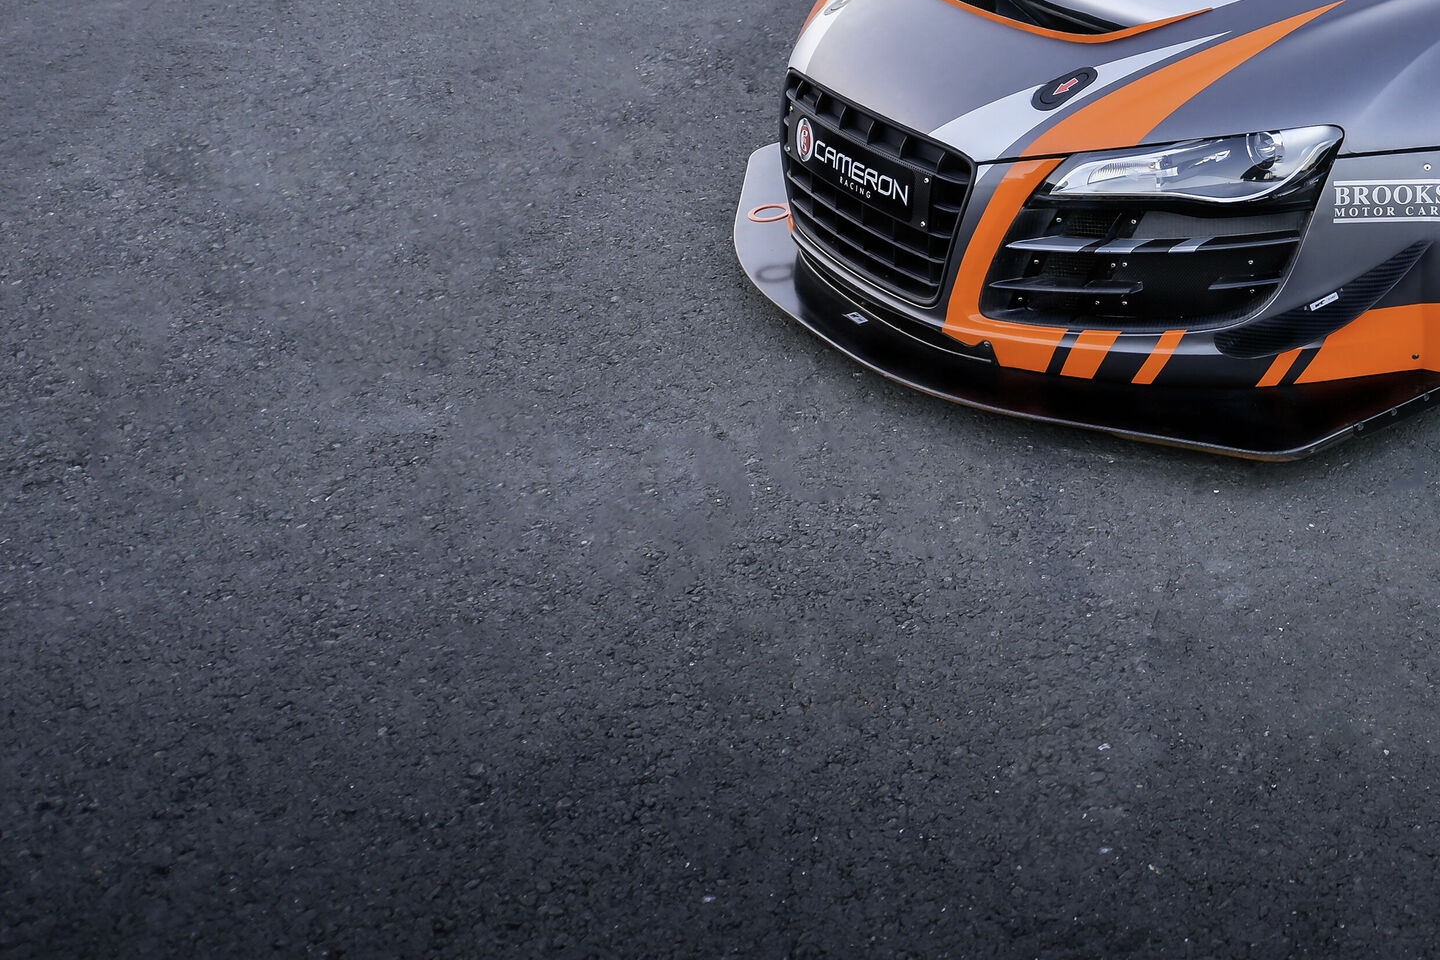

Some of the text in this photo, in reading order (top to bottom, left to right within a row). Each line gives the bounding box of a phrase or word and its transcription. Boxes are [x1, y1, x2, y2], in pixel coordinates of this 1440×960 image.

[815, 140, 908, 206] CAMERON
[840, 176, 871, 199] RACING
[1334, 206, 1396, 217] MOTOR
